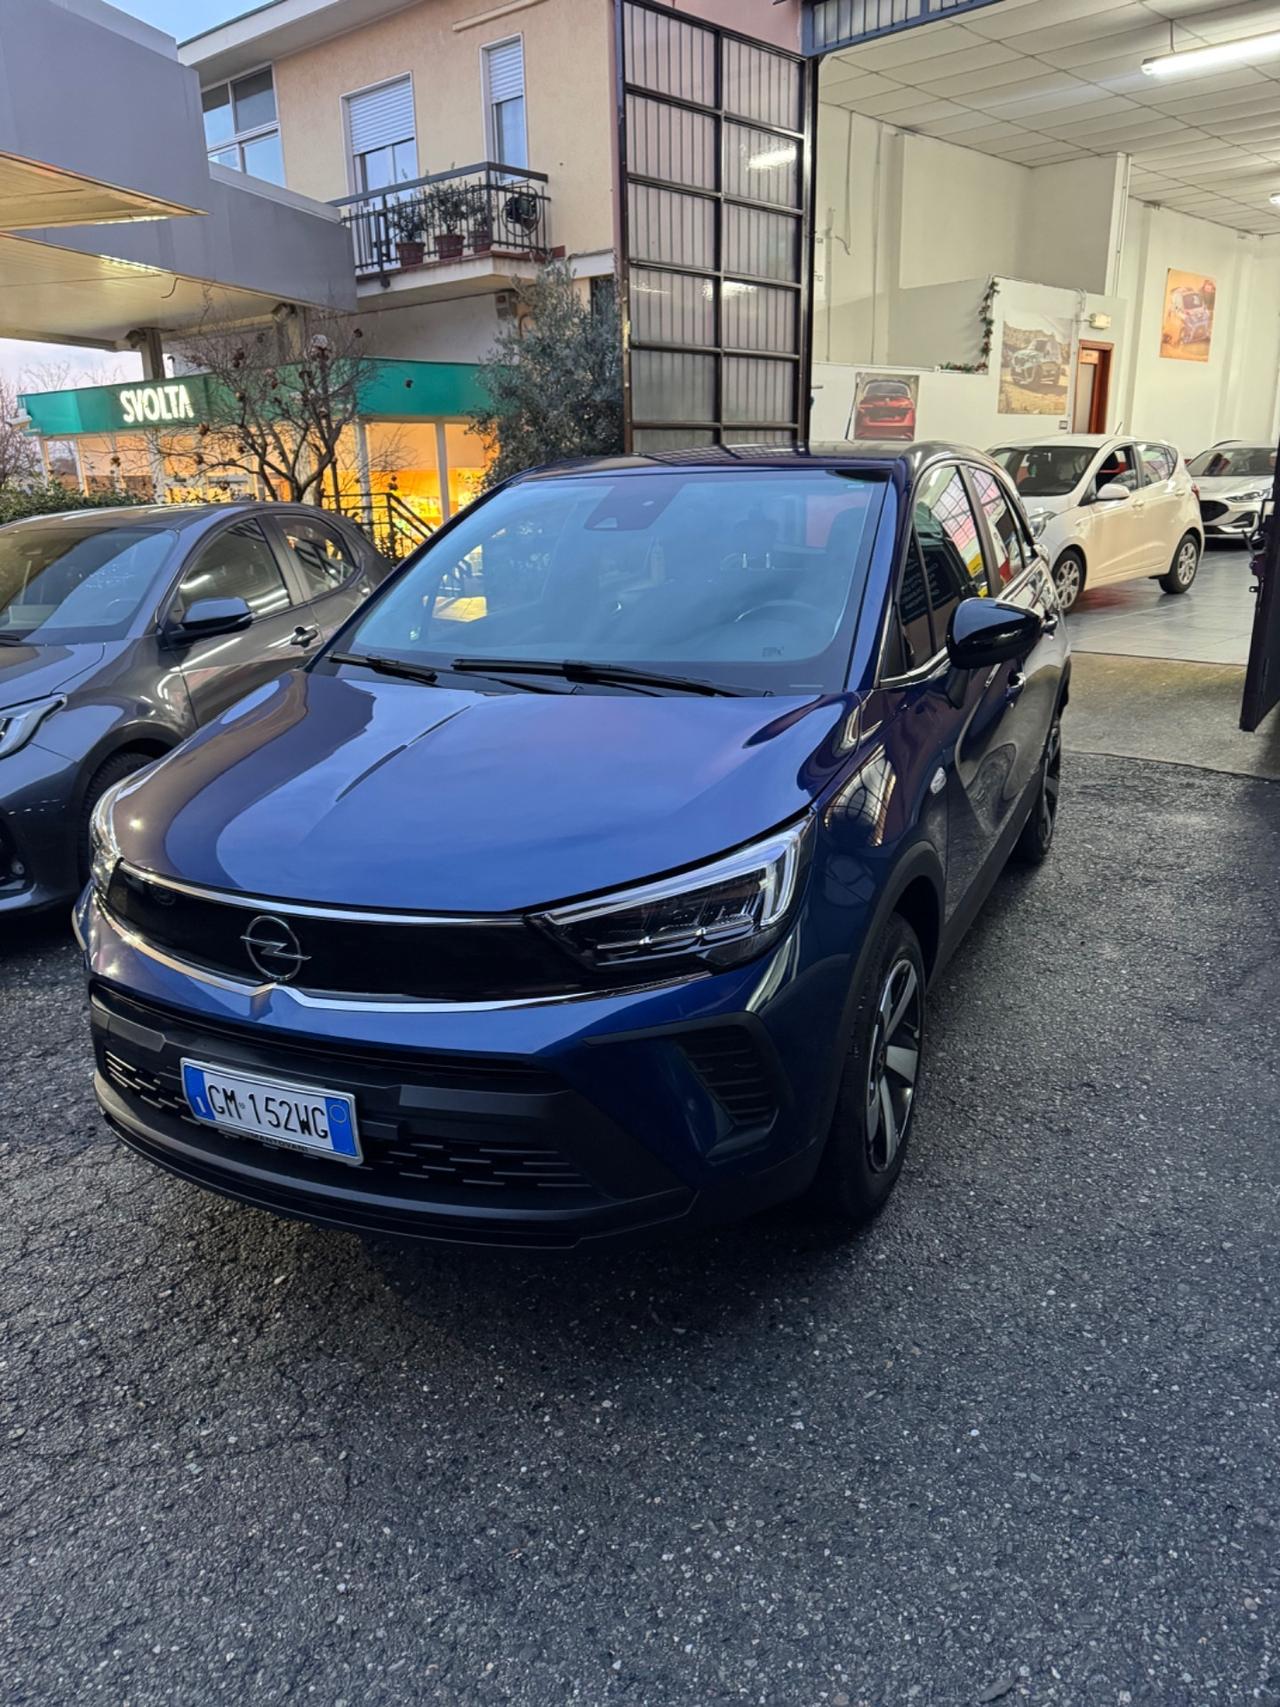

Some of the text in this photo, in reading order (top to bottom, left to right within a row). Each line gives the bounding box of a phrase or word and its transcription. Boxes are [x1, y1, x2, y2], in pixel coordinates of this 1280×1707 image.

[120, 384, 194, 423] SVOLTA
[208, 1085, 328, 1139] GM 152WG
